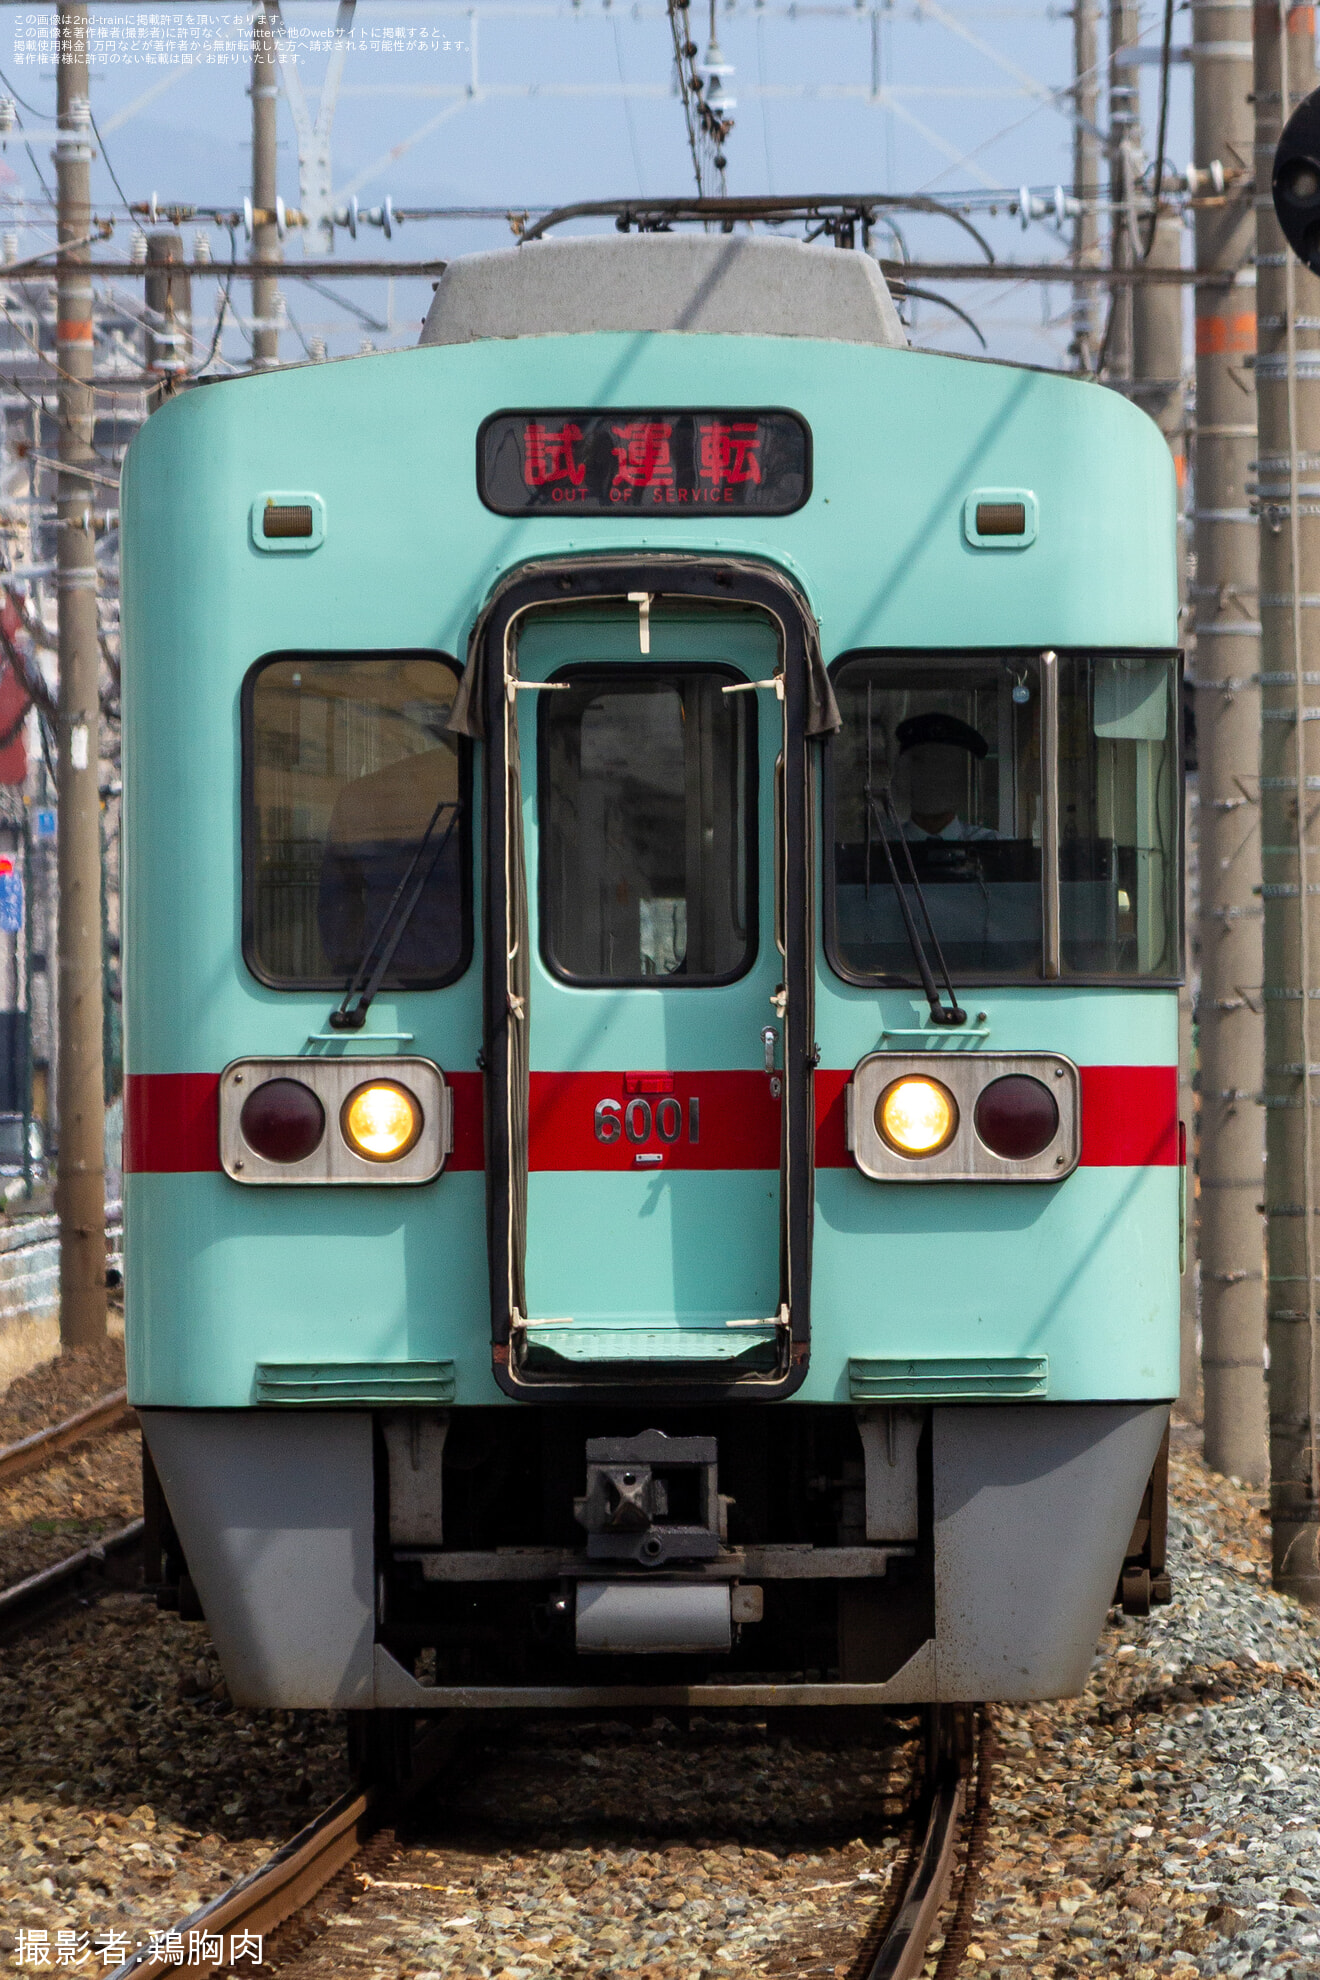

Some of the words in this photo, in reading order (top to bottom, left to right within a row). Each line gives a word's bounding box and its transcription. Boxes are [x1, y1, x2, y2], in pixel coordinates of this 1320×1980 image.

[523, 422, 761, 486] 試運転
[551, 487, 588, 502] OUT
[609, 487, 633, 502] OF
[652, 487, 734, 503] SERVICE
[594, 1097, 700, 1144] 6001
